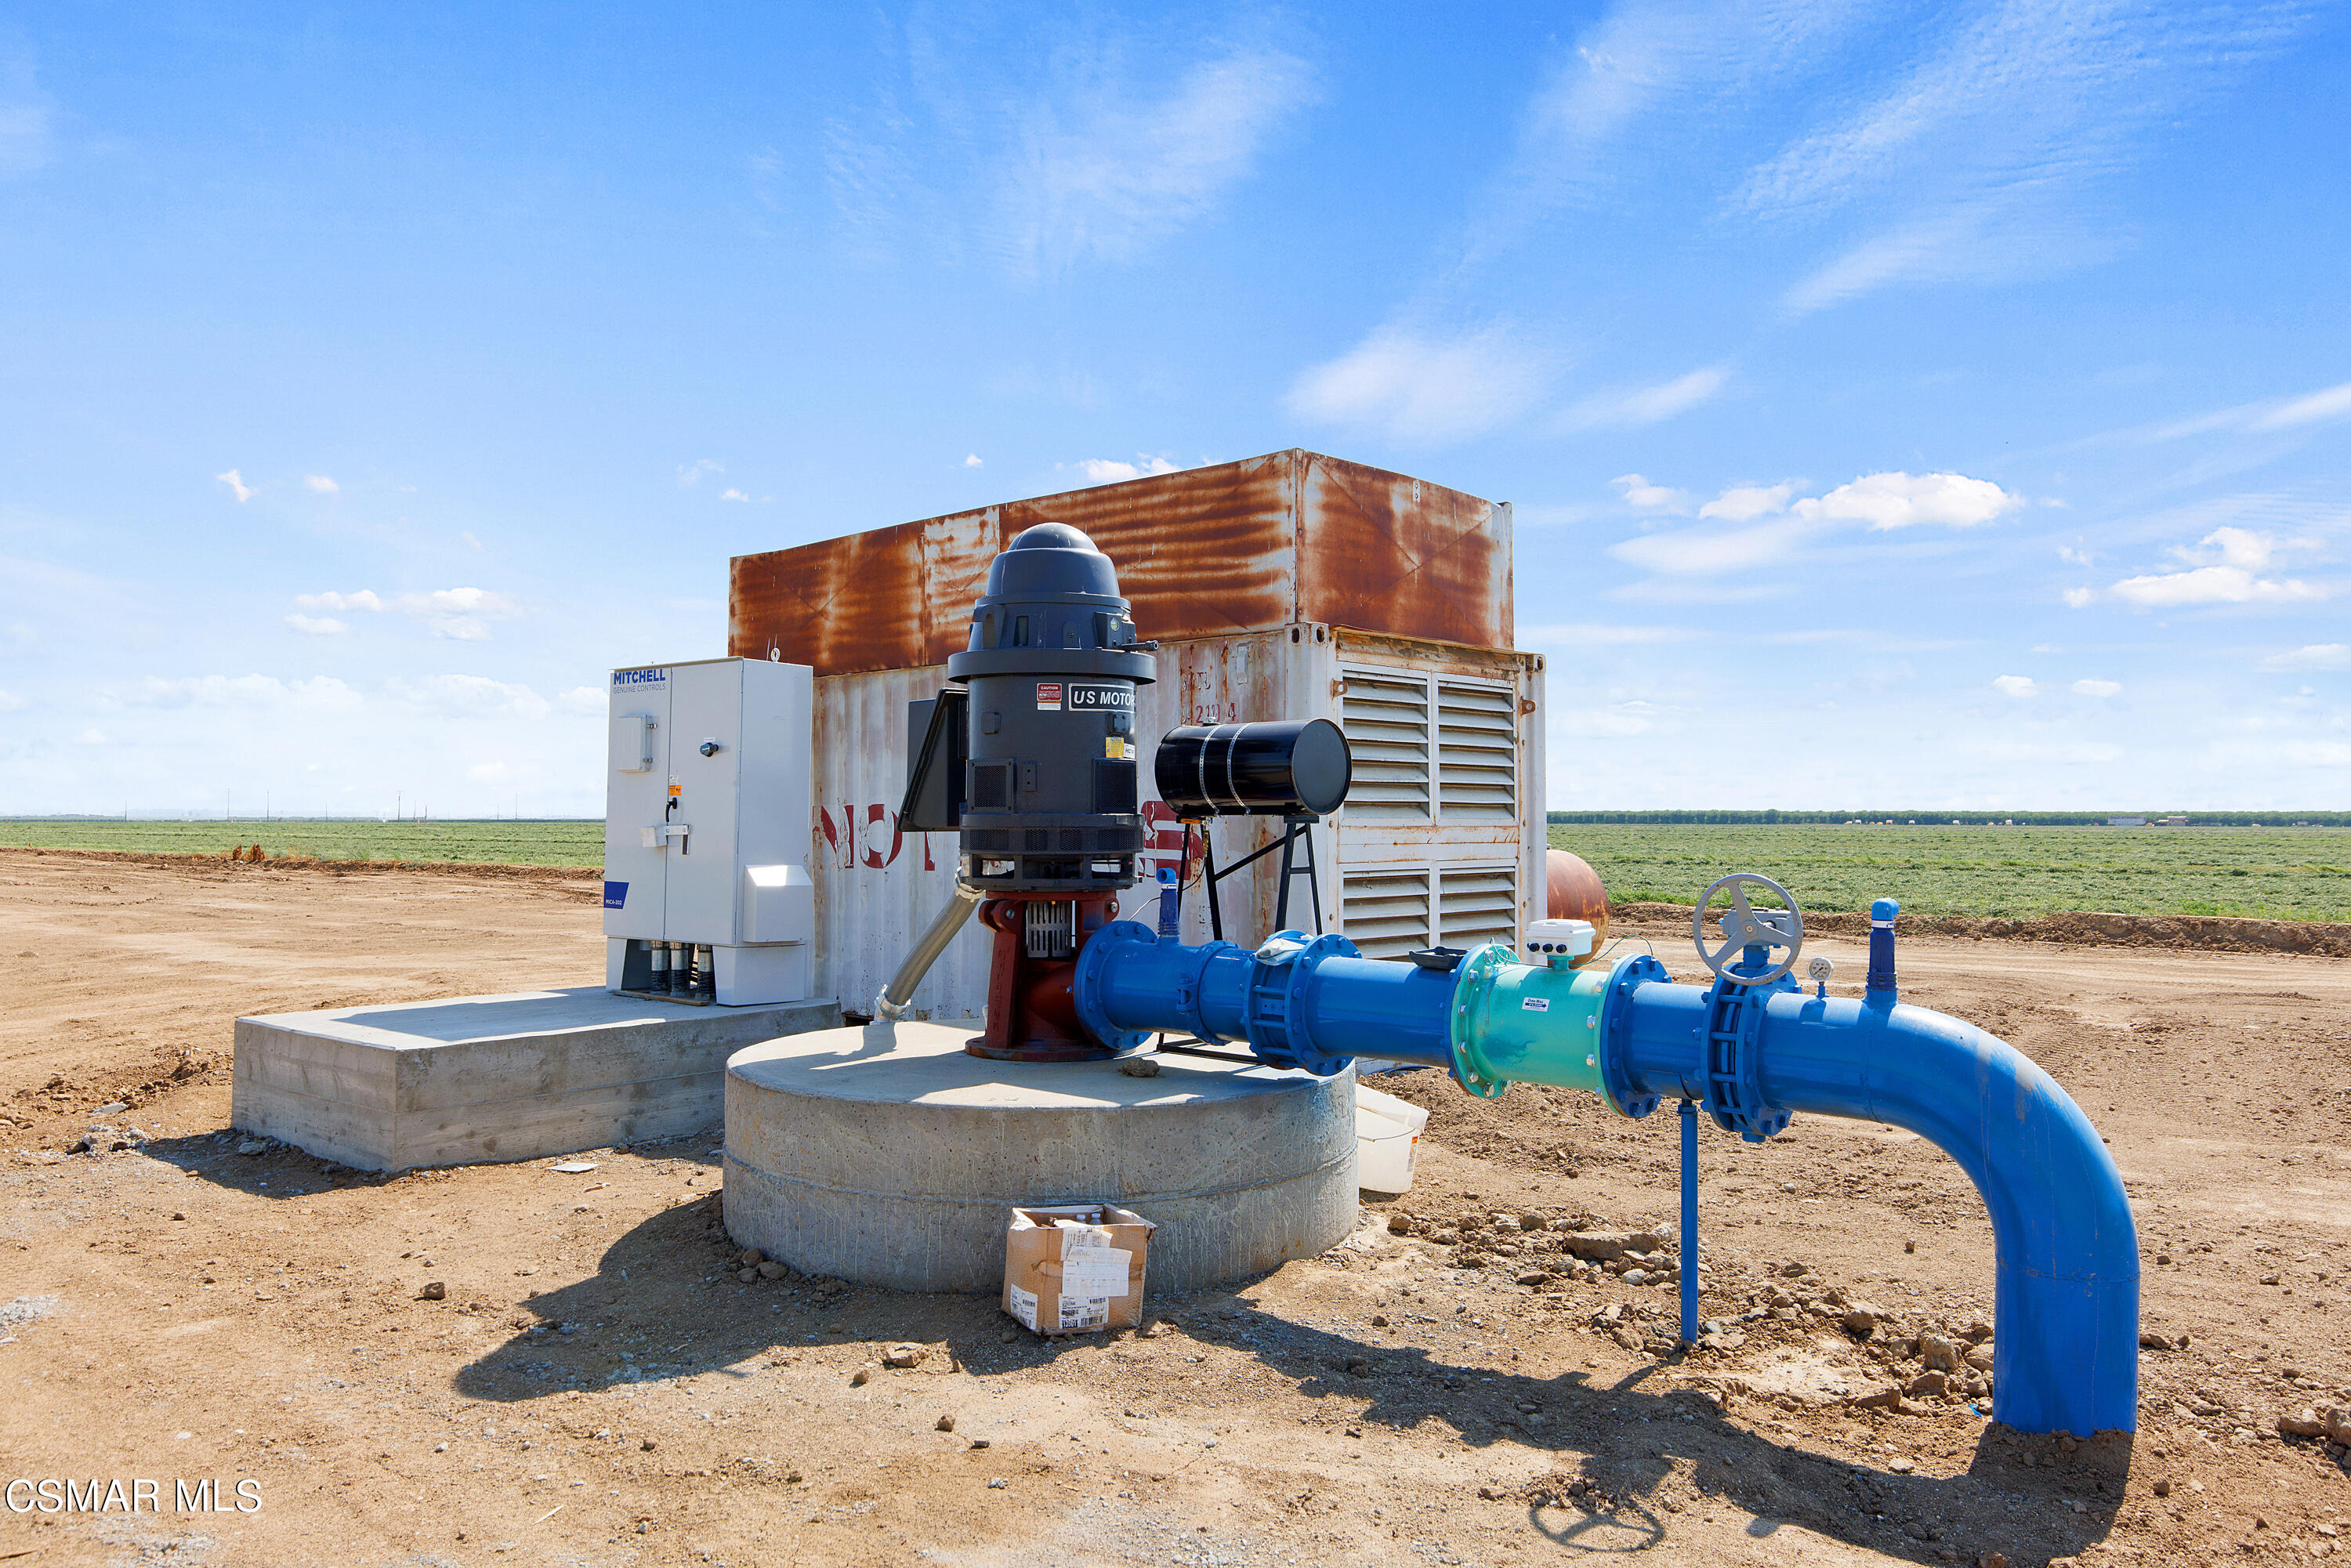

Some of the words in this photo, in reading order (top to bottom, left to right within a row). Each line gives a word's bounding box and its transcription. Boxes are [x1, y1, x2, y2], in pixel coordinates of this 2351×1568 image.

[614, 668, 665, 685] MITCHELL
[613, 685, 636, 694] GENUINE
[636, 683, 666, 693] CONTROLS
[1074, 690, 1096, 704] US
